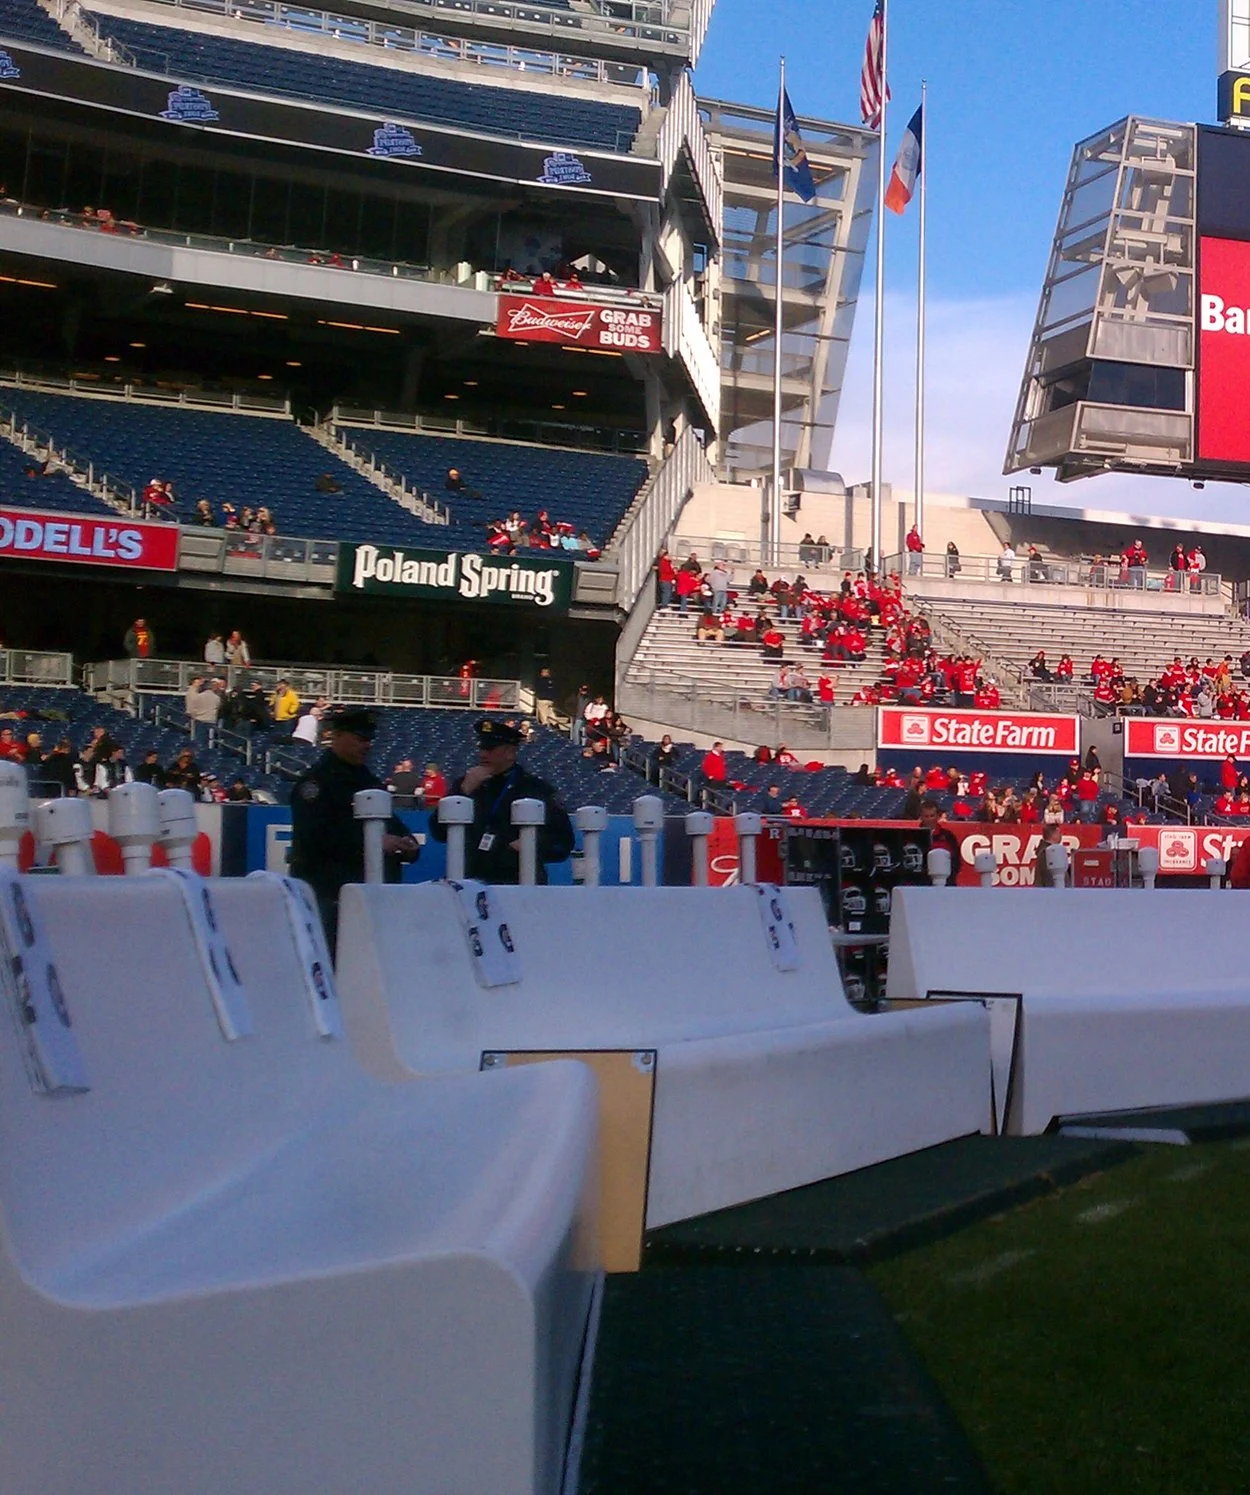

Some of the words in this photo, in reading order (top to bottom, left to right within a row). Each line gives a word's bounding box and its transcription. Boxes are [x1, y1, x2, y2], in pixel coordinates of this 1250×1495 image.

[507, 308, 592, 331] Budweiser
[600, 309, 652, 328] GRAB
[608, 323, 643, 335] SOME
[599, 330, 651, 349] BUDS
[352, 544, 458, 589] Poland
[458, 553, 556, 606] Spring
